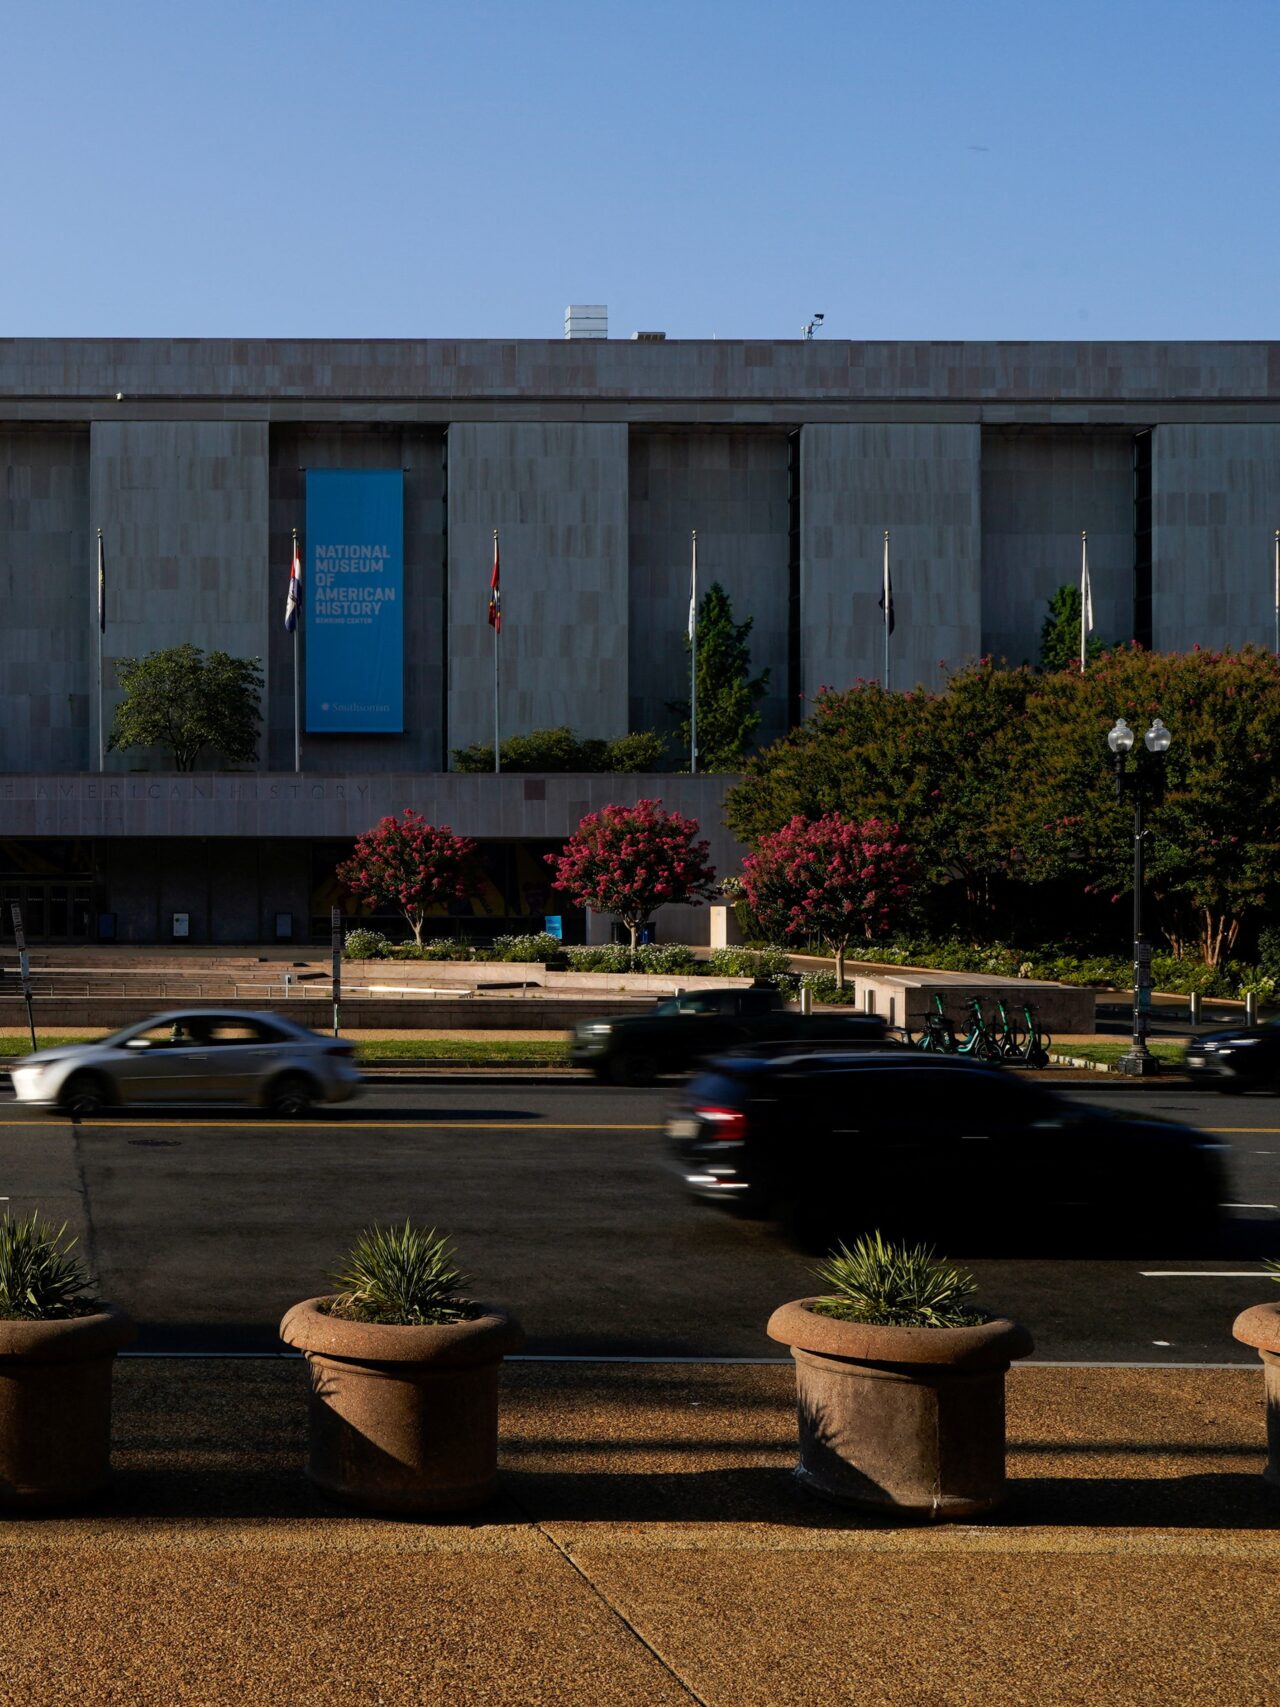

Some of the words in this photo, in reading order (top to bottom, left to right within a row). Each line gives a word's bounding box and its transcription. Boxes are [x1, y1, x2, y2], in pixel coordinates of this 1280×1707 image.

[315, 544, 391, 558] NATIONAL
[315, 559, 384, 573] MUSEUM
[315, 573, 335, 586] OF
[315, 587, 396, 601] AMERICAN
[315, 601, 382, 615] HISTORY
[332, 702, 391, 712] Smithsonian
[36, 783, 208, 799] AMERICAN
[230, 784, 369, 800] HISTORY
